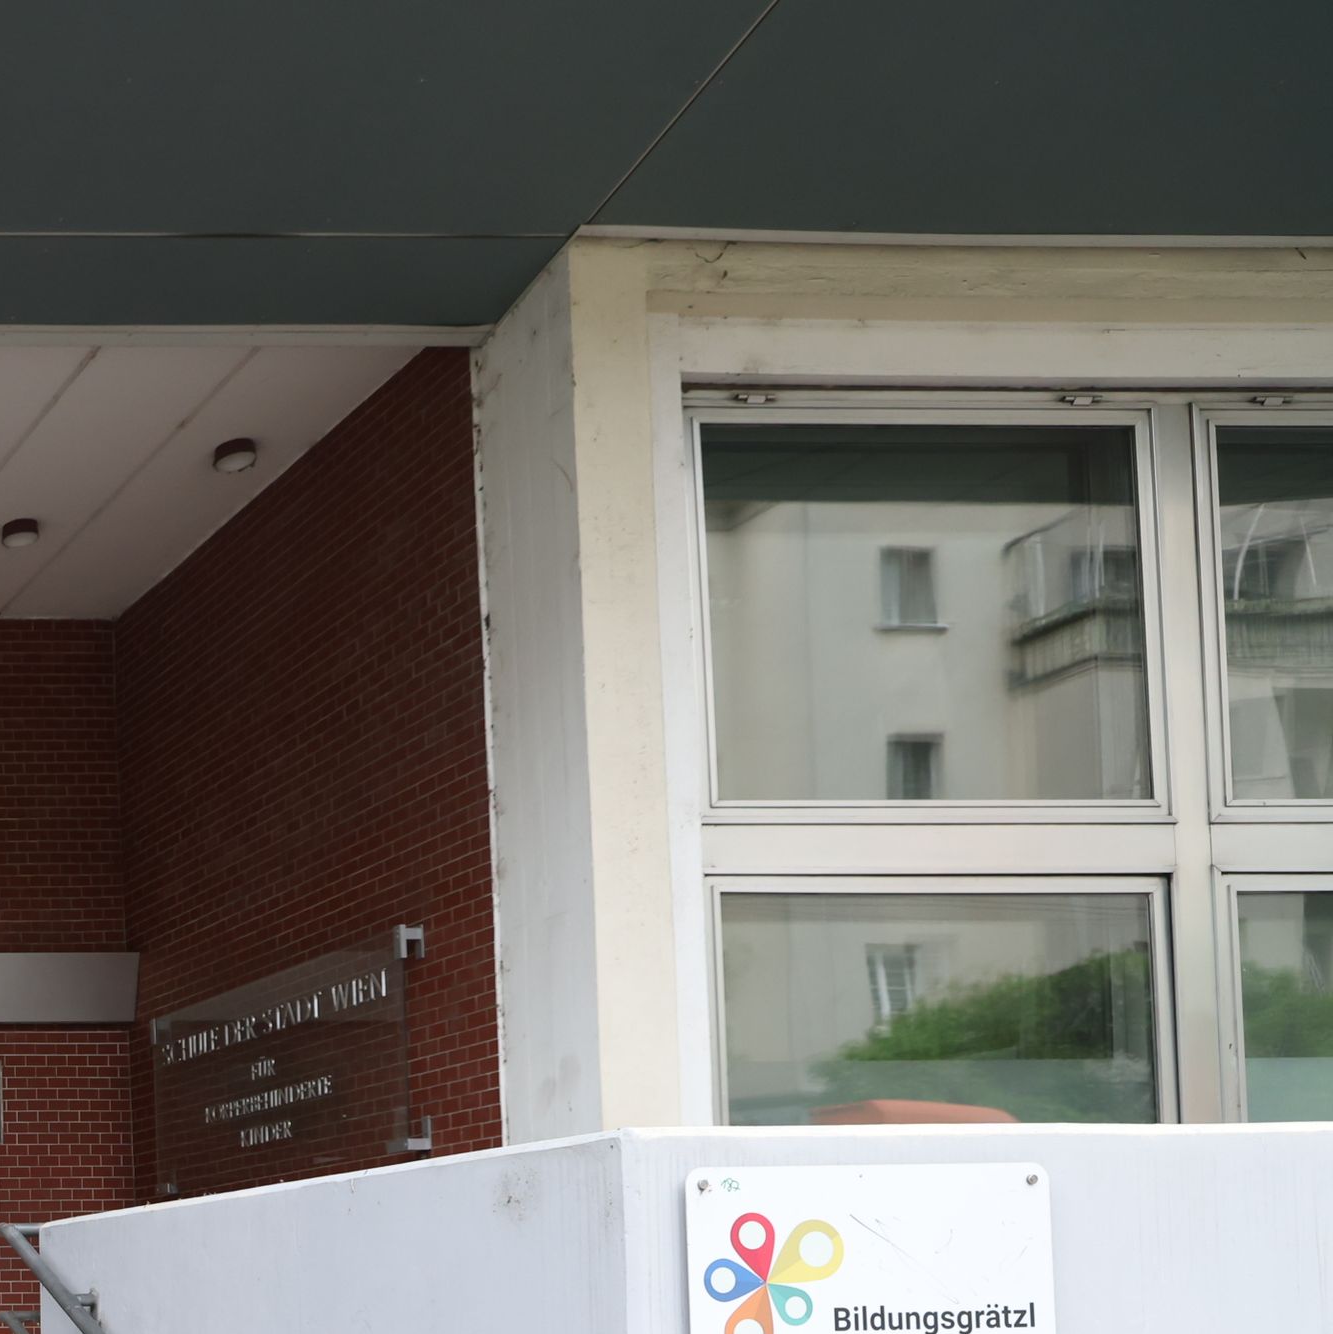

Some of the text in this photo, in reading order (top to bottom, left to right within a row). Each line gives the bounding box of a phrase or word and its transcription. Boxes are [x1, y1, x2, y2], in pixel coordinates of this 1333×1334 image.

[161, 967, 388, 1066] SCHULE DER STADT WIEN
[250, 1056, 277, 1081] FÜR
[240, 1120, 293, 1148] KINDER
